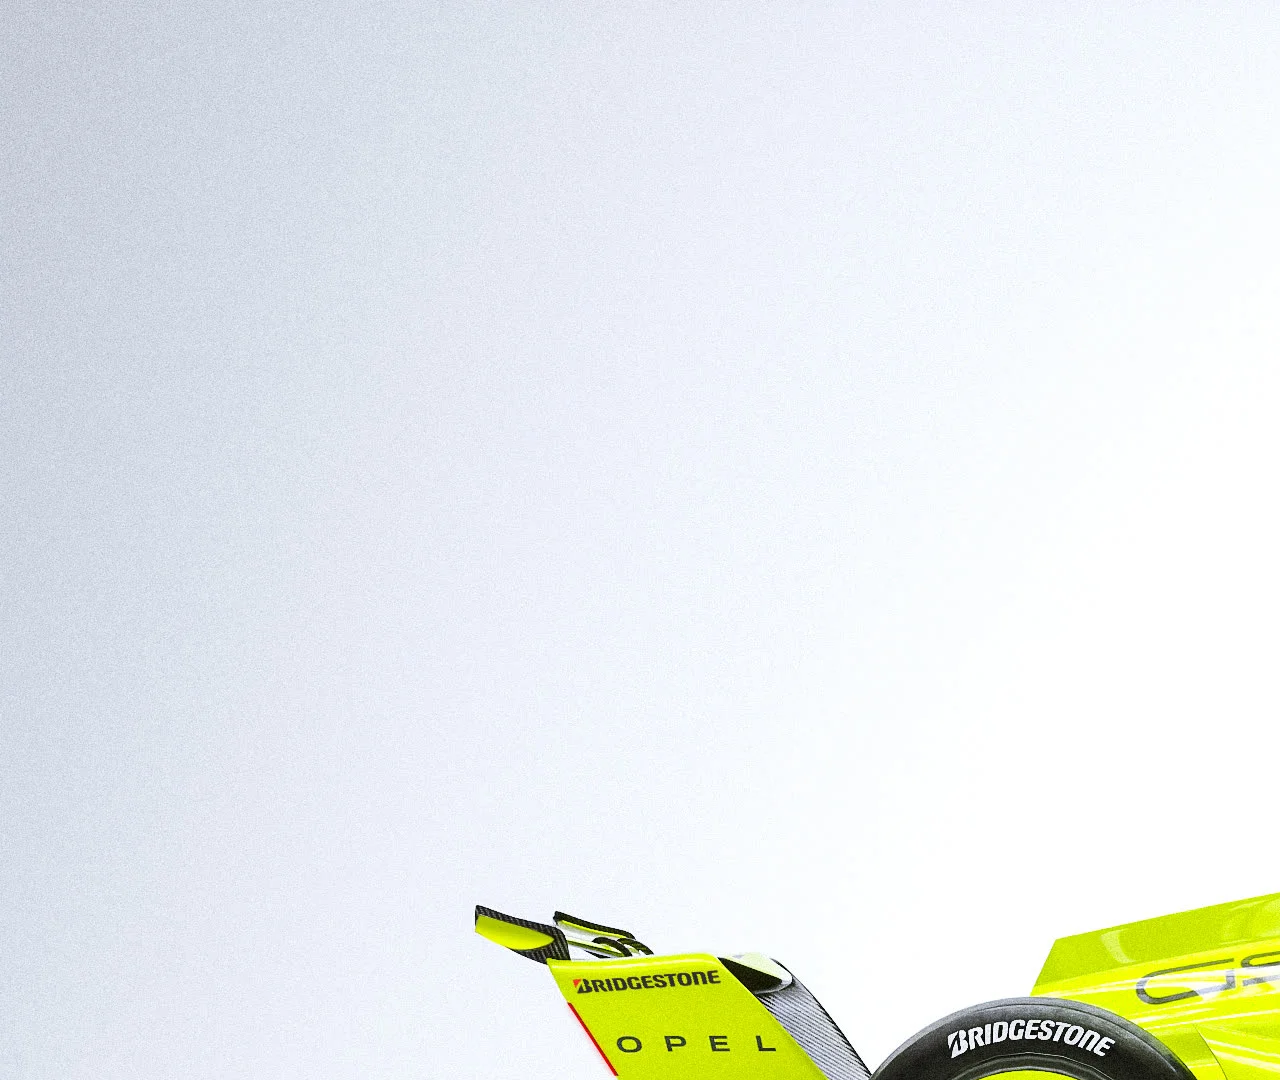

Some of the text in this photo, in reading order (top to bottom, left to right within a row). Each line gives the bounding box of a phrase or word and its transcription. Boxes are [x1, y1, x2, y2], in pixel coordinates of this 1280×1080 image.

[573, 970, 721, 994] BRIDGESTONE
[616, 1035, 777, 1053] OPEL
[948, 1019, 1115, 1058] BRIDGESTONE
